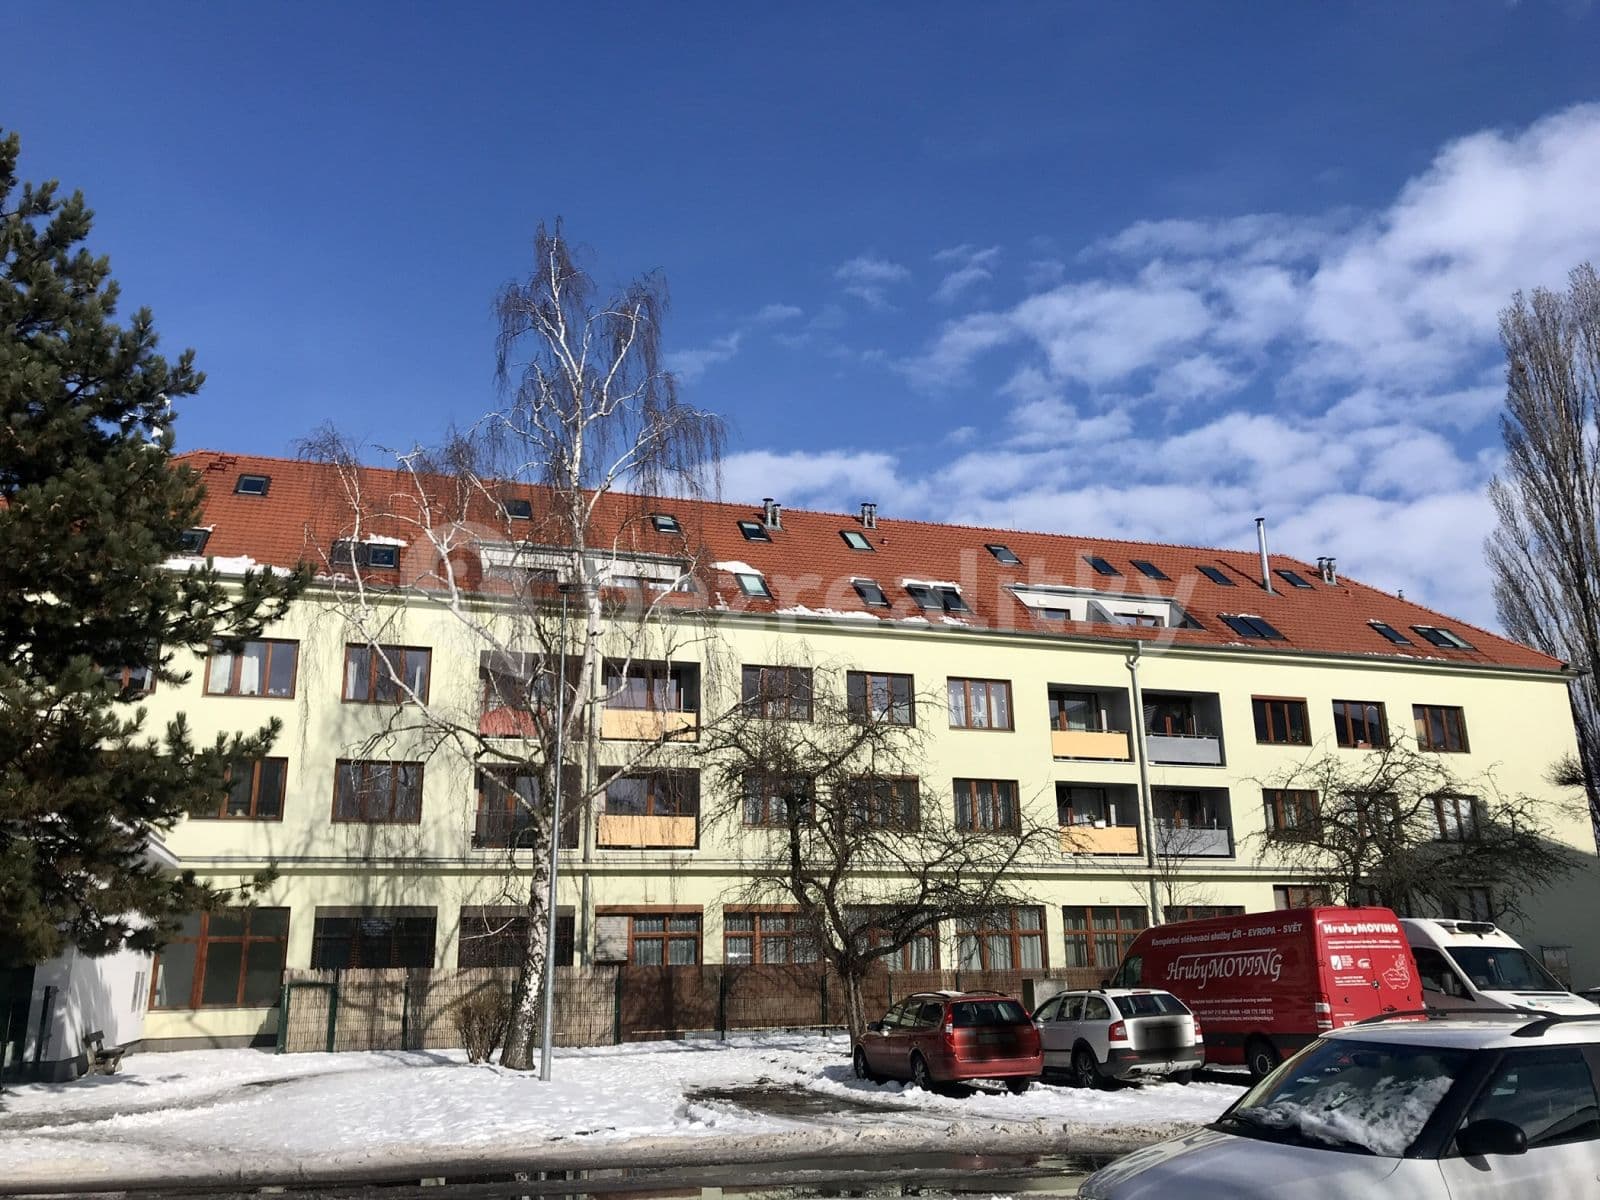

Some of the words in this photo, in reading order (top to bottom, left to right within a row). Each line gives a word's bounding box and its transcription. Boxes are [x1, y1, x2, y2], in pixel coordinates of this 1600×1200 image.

[1231, 928, 1242, 939] ČR
[1248, 925, 1276, 937] EVROPA
[1282, 921, 1303, 934] SVĚT
[1322, 922, 1399, 936] HrubyMOVING
[1166, 948, 1283, 990] HrubyMOVING
